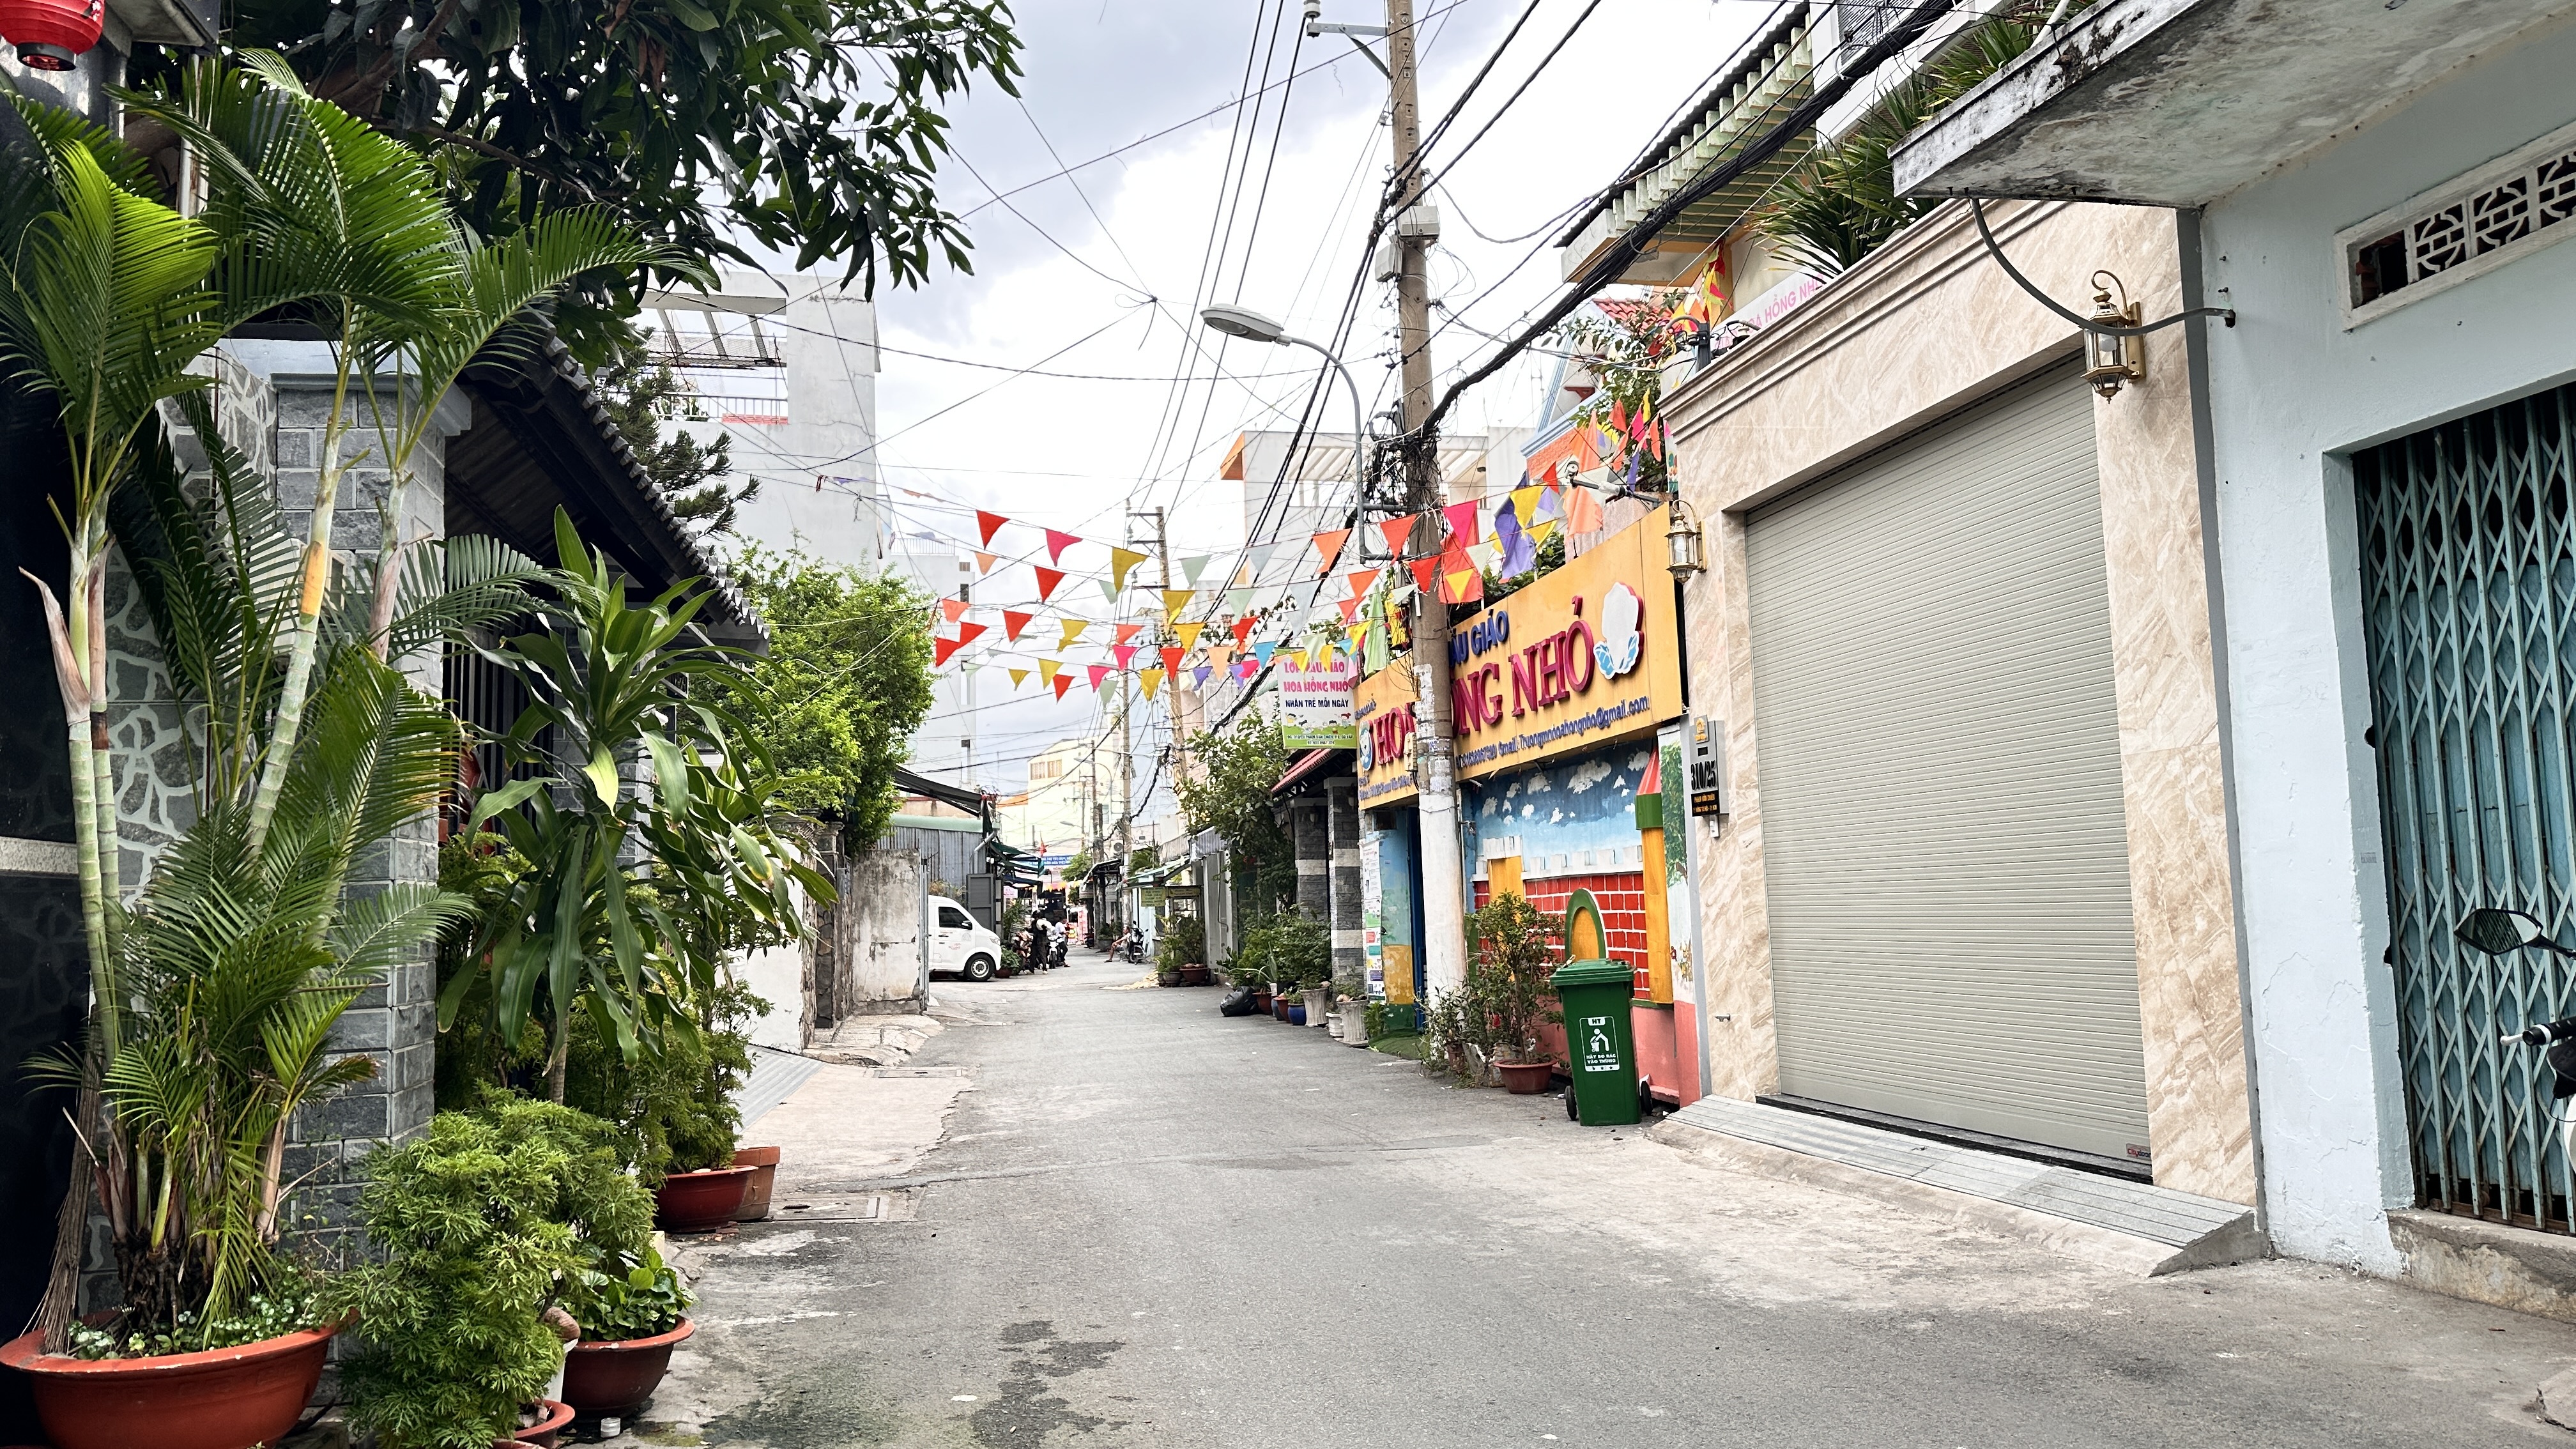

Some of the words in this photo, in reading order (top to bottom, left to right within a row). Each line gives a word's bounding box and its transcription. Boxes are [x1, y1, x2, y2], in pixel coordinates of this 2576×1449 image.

[1765, 291, 1797, 324] HỒNG
[1471, 609, 1509, 656] GIÁO
[1508, 595, 1595, 717] NHỎ
[1284, 681, 1302, 692] HOA
[1303, 676, 1328, 692] HỒNG
[1330, 677, 1349, 692] NHỎ
[1285, 698, 1303, 709] NHẬN
[1332, 697, 1349, 707] NGÀY
[1690, 760, 1717, 790] 310/25
